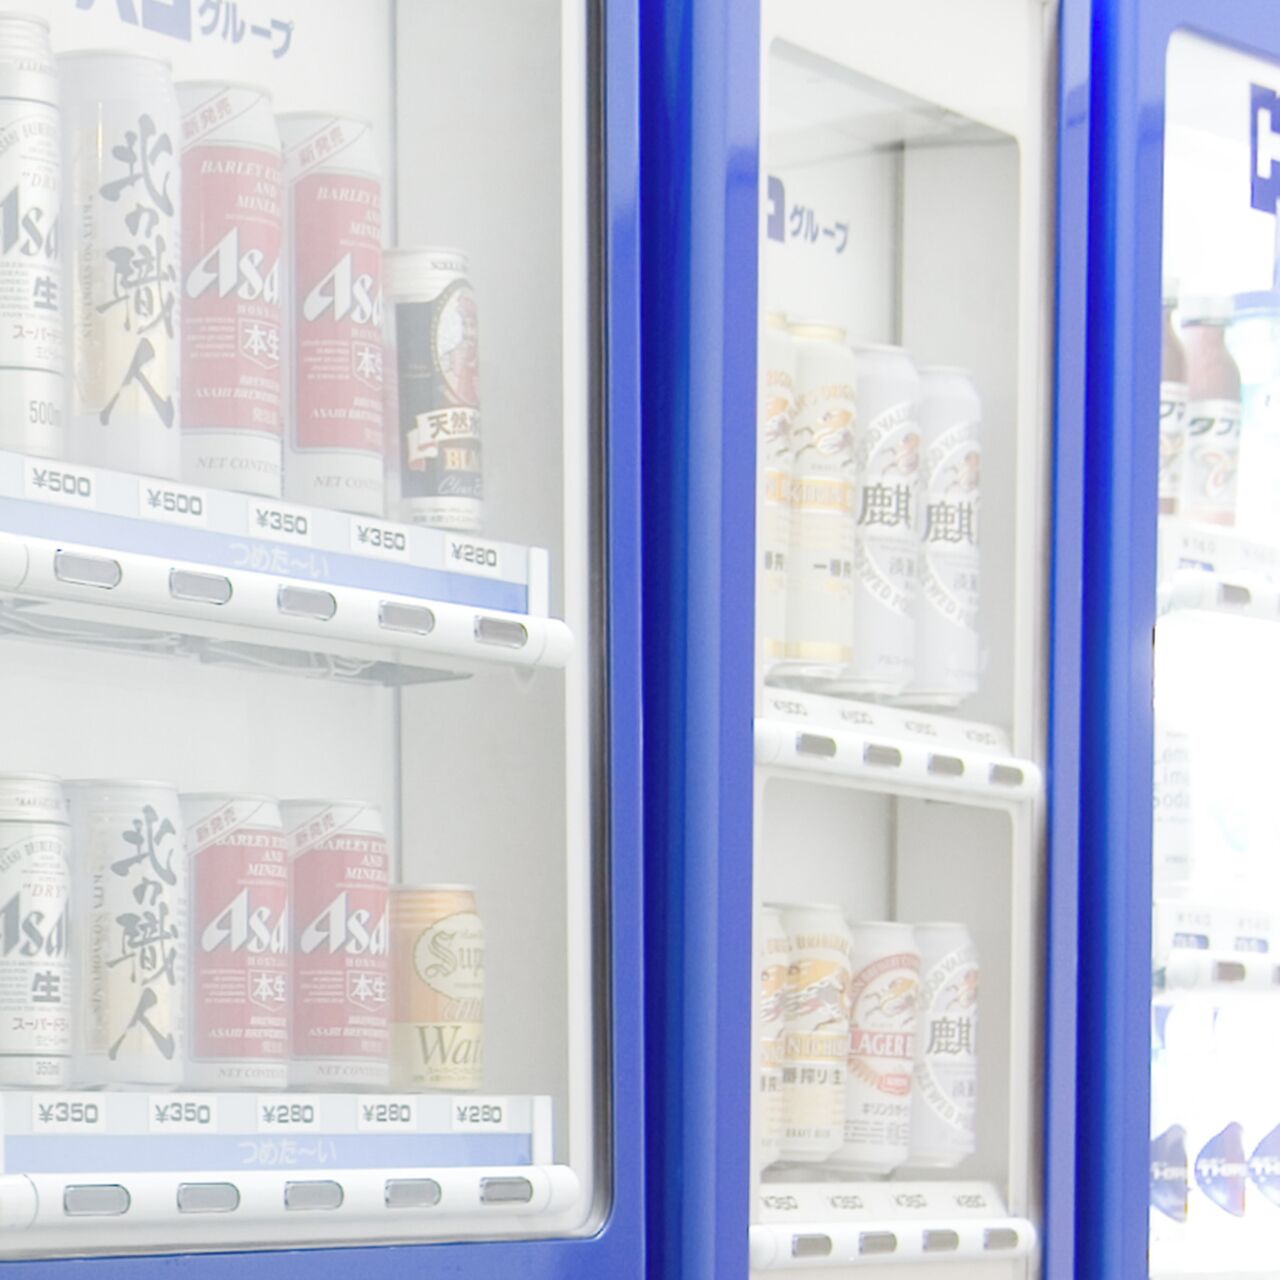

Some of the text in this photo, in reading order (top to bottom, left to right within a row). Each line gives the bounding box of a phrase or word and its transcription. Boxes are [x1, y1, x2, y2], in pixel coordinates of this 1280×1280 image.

[789, 203, 850, 254] グループ
[96, 113, 175, 428] 北の職人
[33, 276, 59, 312] 生
[32, 467, 91, 498] ¥500
[147, 488, 202, 517] ¥500
[255, 508, 308, 535] ¥350
[357, 524, 406, 551] ¥350
[452, 541, 497, 568] ¥280
[105, 804, 178, 1062] 北の職人
[31, 970, 61, 1004] 生
[253, 973, 286, 1002] 本生
[351, 973, 387, 1002] 本生
[38, 1101, 98, 1125] ¥350
[155, 1102, 211, 1126] ¥350
[262, 1103, 314, 1125] ¥280
[363, 1103, 411, 1124] ¥280
[456, 1103, 502, 1125] ¥280
